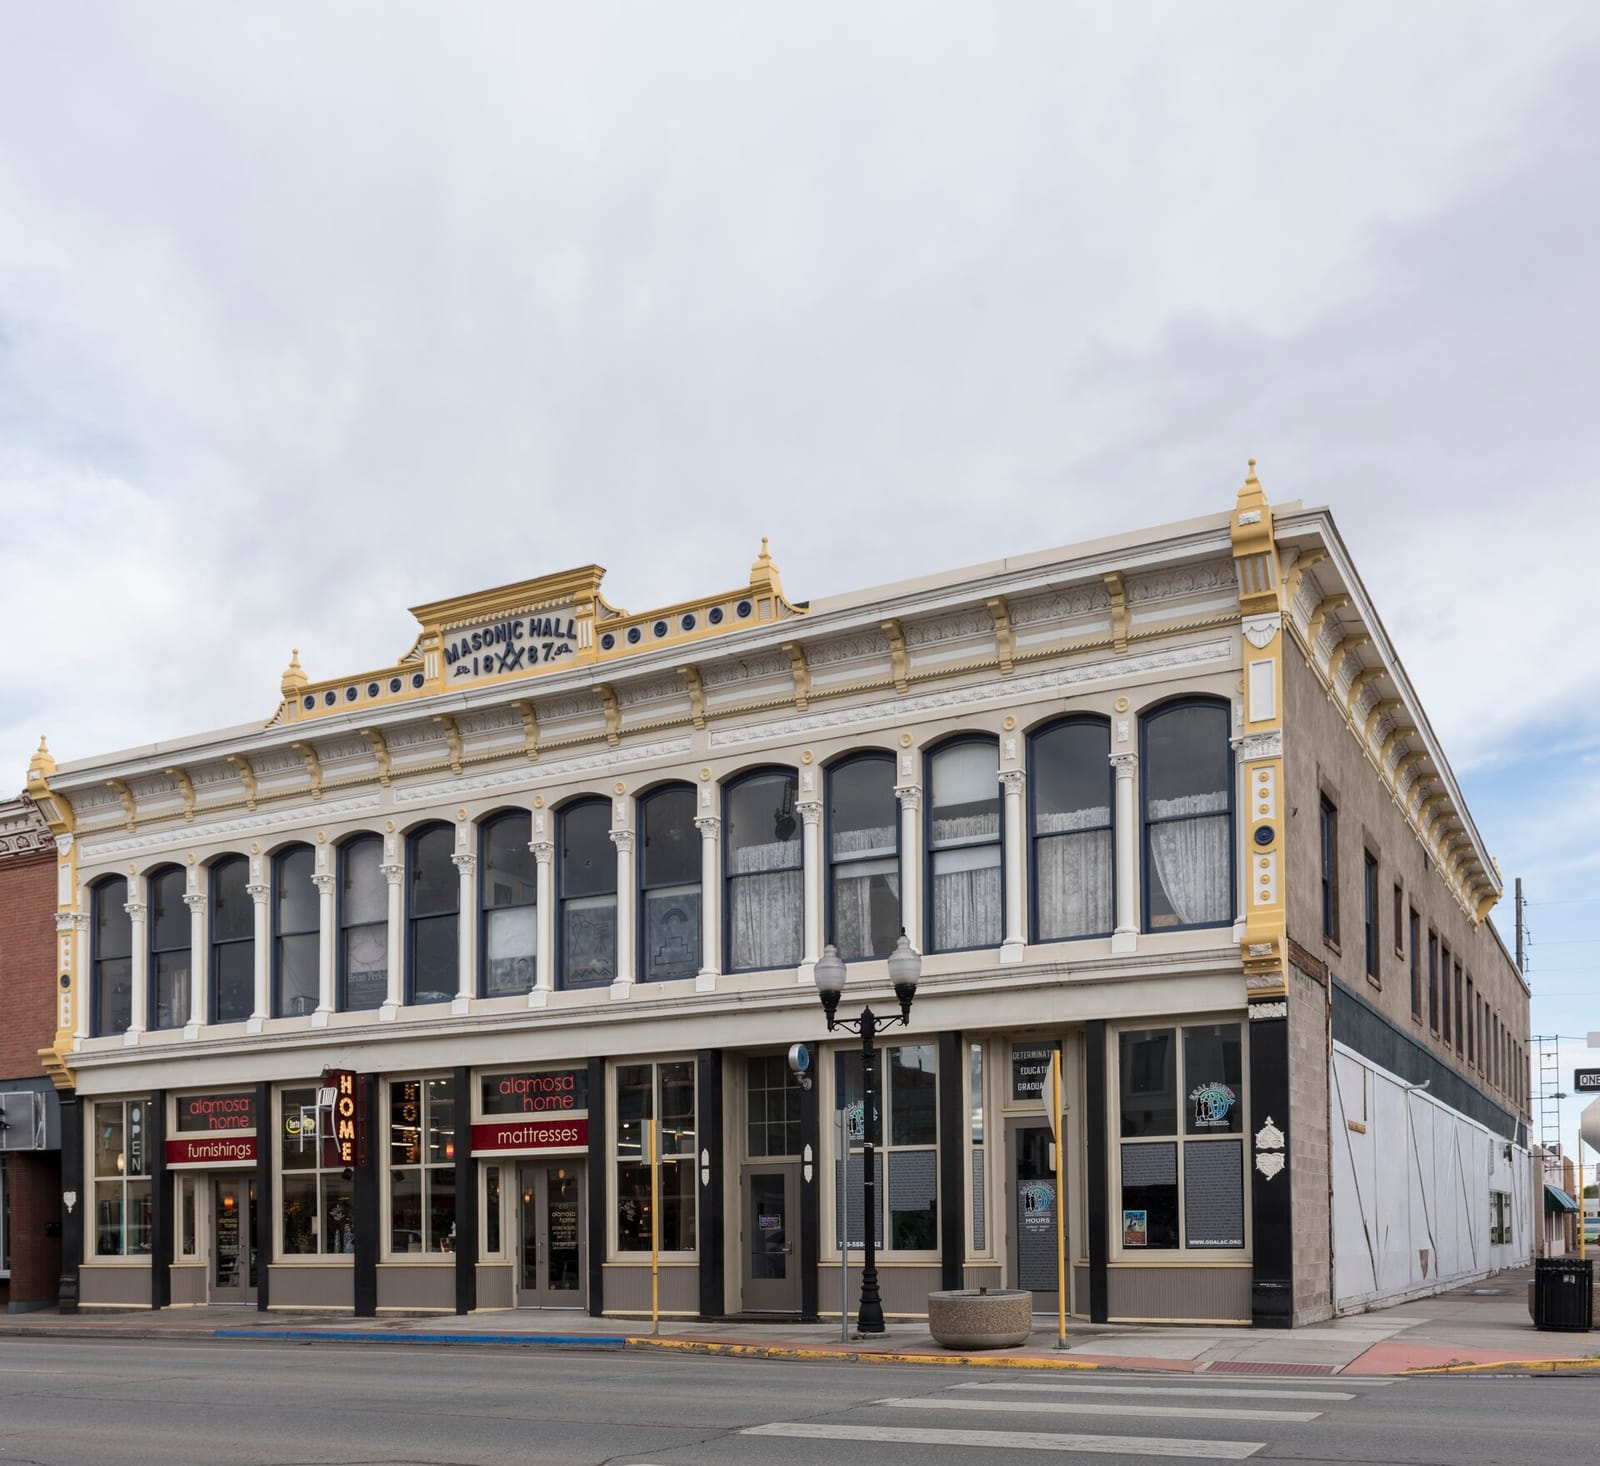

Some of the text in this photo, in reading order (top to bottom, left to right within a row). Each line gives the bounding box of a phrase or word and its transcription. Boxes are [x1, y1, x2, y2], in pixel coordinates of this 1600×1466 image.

[444, 617, 578, 665] MASONIC HALL
[1012, 1050, 1050, 1060] DETERMINAT
[1020, 1066, 1048, 1075] EDUCATI
[499, 1075, 575, 1095] alamosa
[1017, 1081, 1043, 1091] GRADUA
[189, 1097, 249, 1114] alamosa
[523, 1094, 574, 1112] home
[208, 1114, 249, 1129] home
[339, 1074, 355, 1161] HOME
[132, 1108, 141, 1172] OPEN
[498, 1127, 578, 1144] mattresses
[188, 1142, 251, 1159] furnishings
